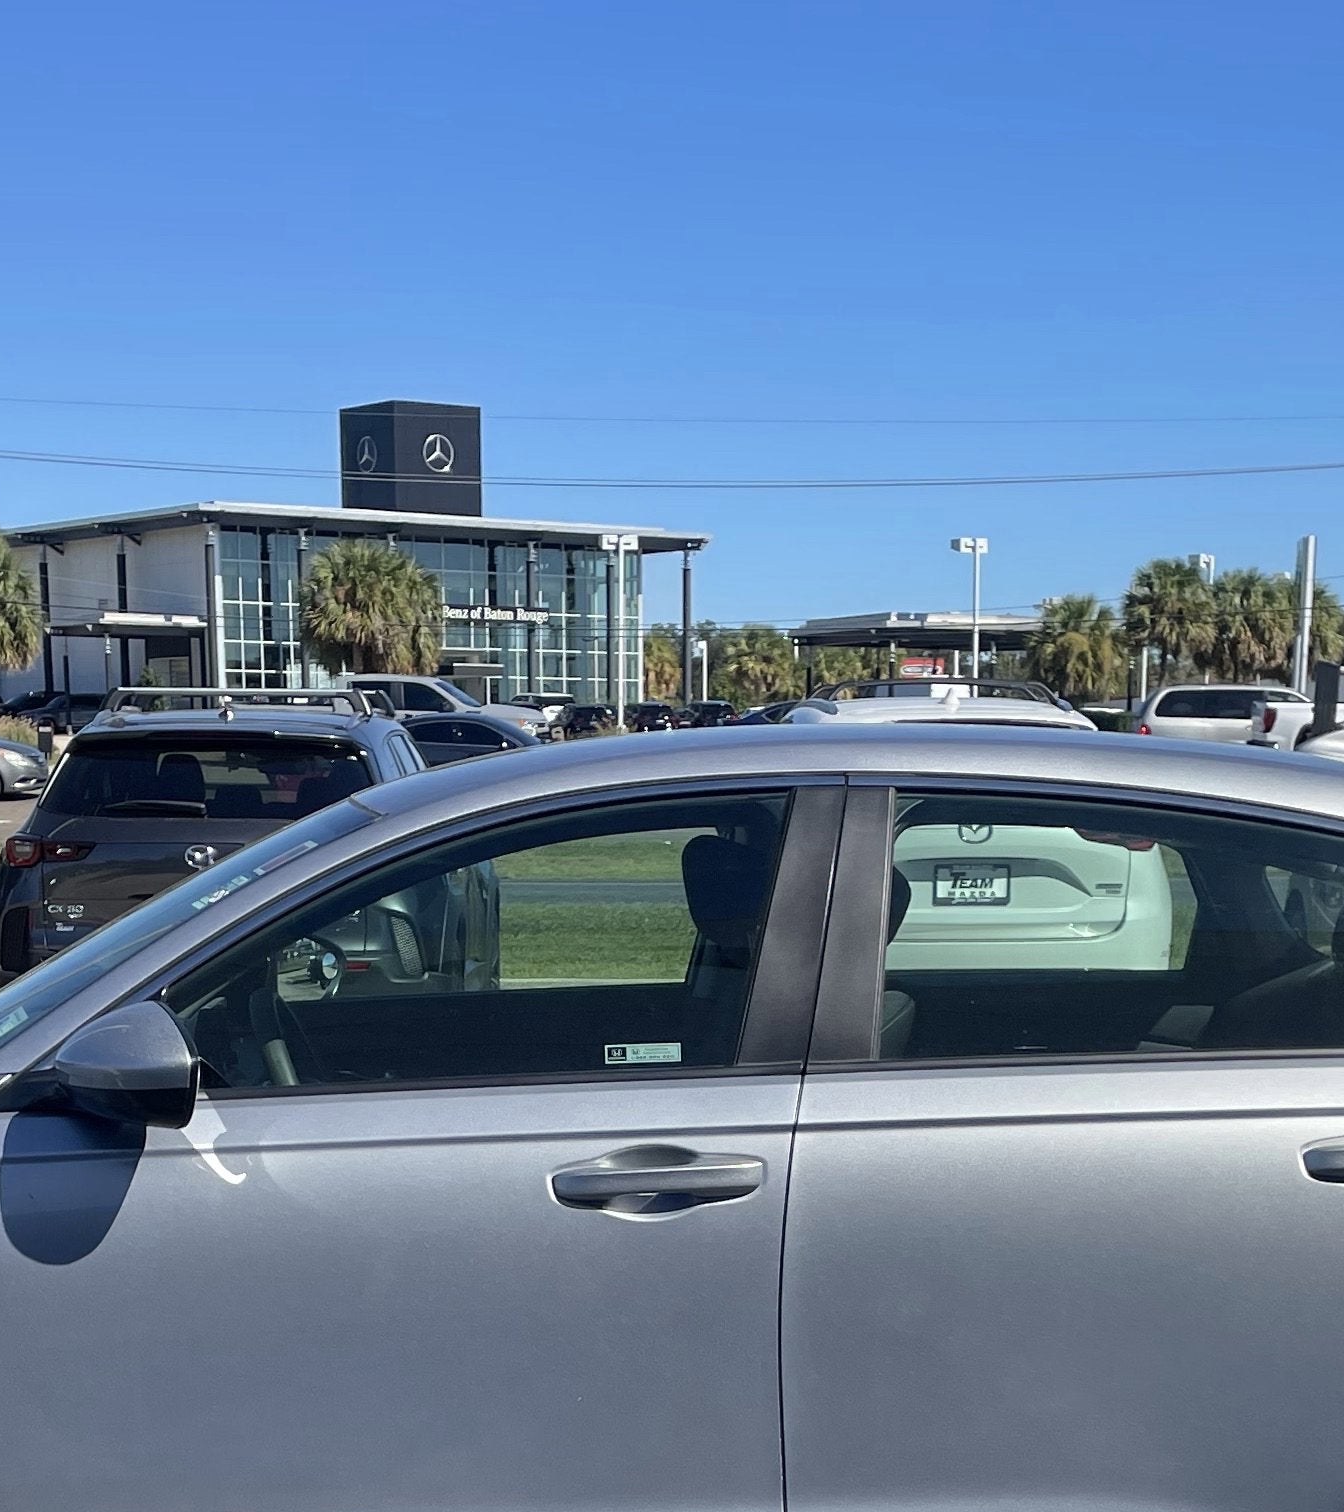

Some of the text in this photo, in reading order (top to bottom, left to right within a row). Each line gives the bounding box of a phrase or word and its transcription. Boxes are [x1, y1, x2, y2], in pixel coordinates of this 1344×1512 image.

[470, 606, 483, 620] of
[483, 606, 514, 621] Baton
[516, 607, 549, 625] Rouge
[950, 871, 994, 889] TEAM
[947, 890, 997, 898] MAZDA
